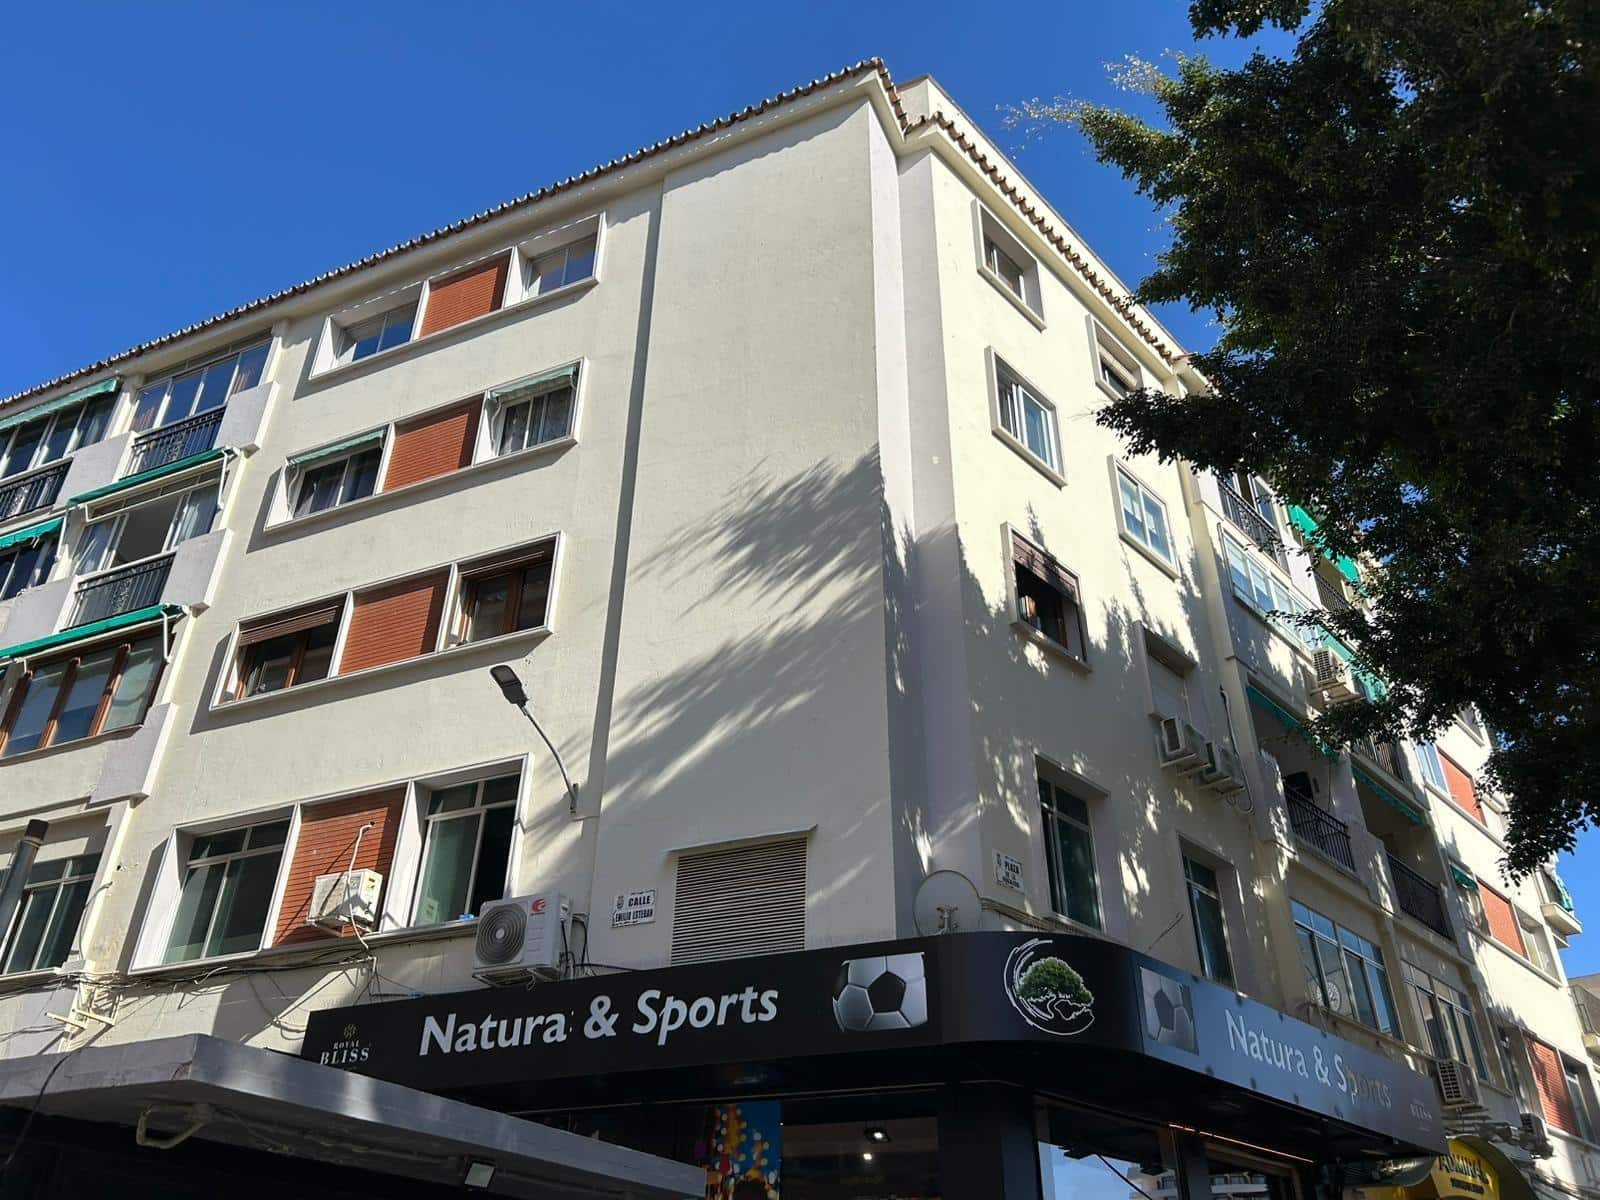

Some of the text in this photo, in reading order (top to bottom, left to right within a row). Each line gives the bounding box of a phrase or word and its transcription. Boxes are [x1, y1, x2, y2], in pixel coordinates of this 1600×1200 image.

[628, 895, 651, 907] CALLE
[418, 986, 780, 1057] Natura & Sports
[333, 1039, 360, 1050] ROYAL
[320, 1047, 370, 1065] BLISS
[1223, 1008, 1393, 1109] Natura & Sports
